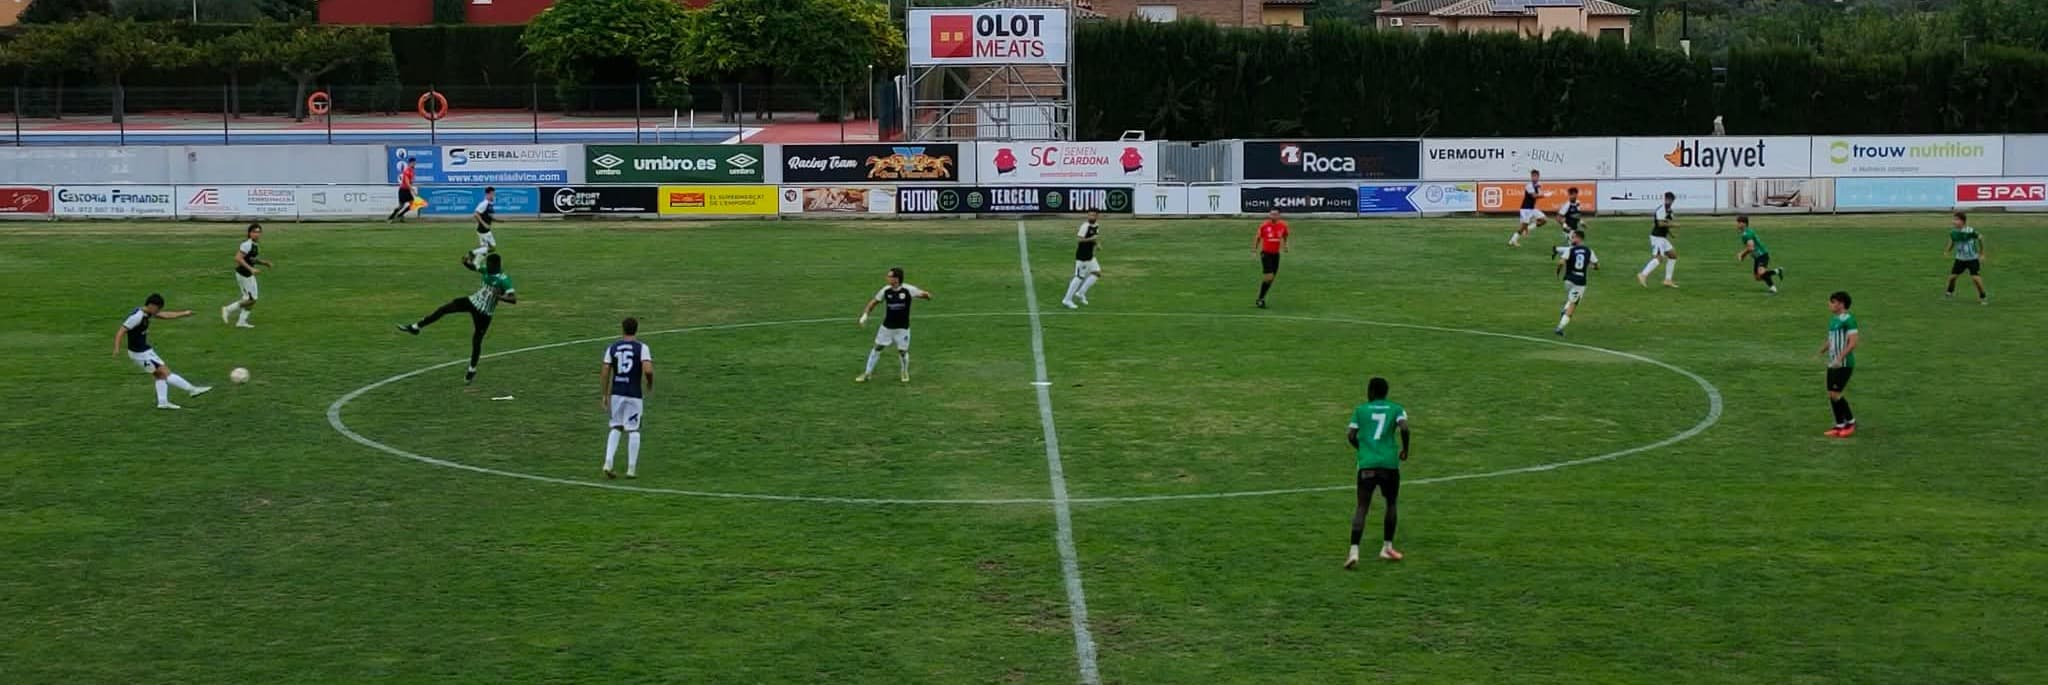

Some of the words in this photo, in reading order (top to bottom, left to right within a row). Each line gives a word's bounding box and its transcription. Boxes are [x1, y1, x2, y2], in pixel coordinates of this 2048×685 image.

[976, 15, 1045, 37] OLOT
[976, 40, 1045, 58] MEATS
[1064, 147, 1097, 155] SEMEN
[1429, 149, 1504, 159] VERMOUTH
[1680, 139, 1766, 175] blayvet
[1853, 144, 1906, 158] trouw
[1909, 142, 1985, 158] nutrition
[634, 154, 717, 171] umbro.es
[788, 156, 828, 171] Racing
[829, 156, 858, 169] Team
[1063, 156, 1110, 165] CARDONA
[1303, 152, 1356, 172] Roca
[447, 172, 560, 182] www.severaladvice.com
[900, 189, 938, 211] FUTUR
[990, 189, 1039, 203] TERCERA
[1069, 189, 1107, 211] FUTUR
[1976, 186, 2044, 199] SPAR
[1273, 197, 1324, 207] SCHMDT
[1575, 254, 1585, 270] 8
[615, 350, 634, 374] 15
[1371, 412, 1386, 440] 7
